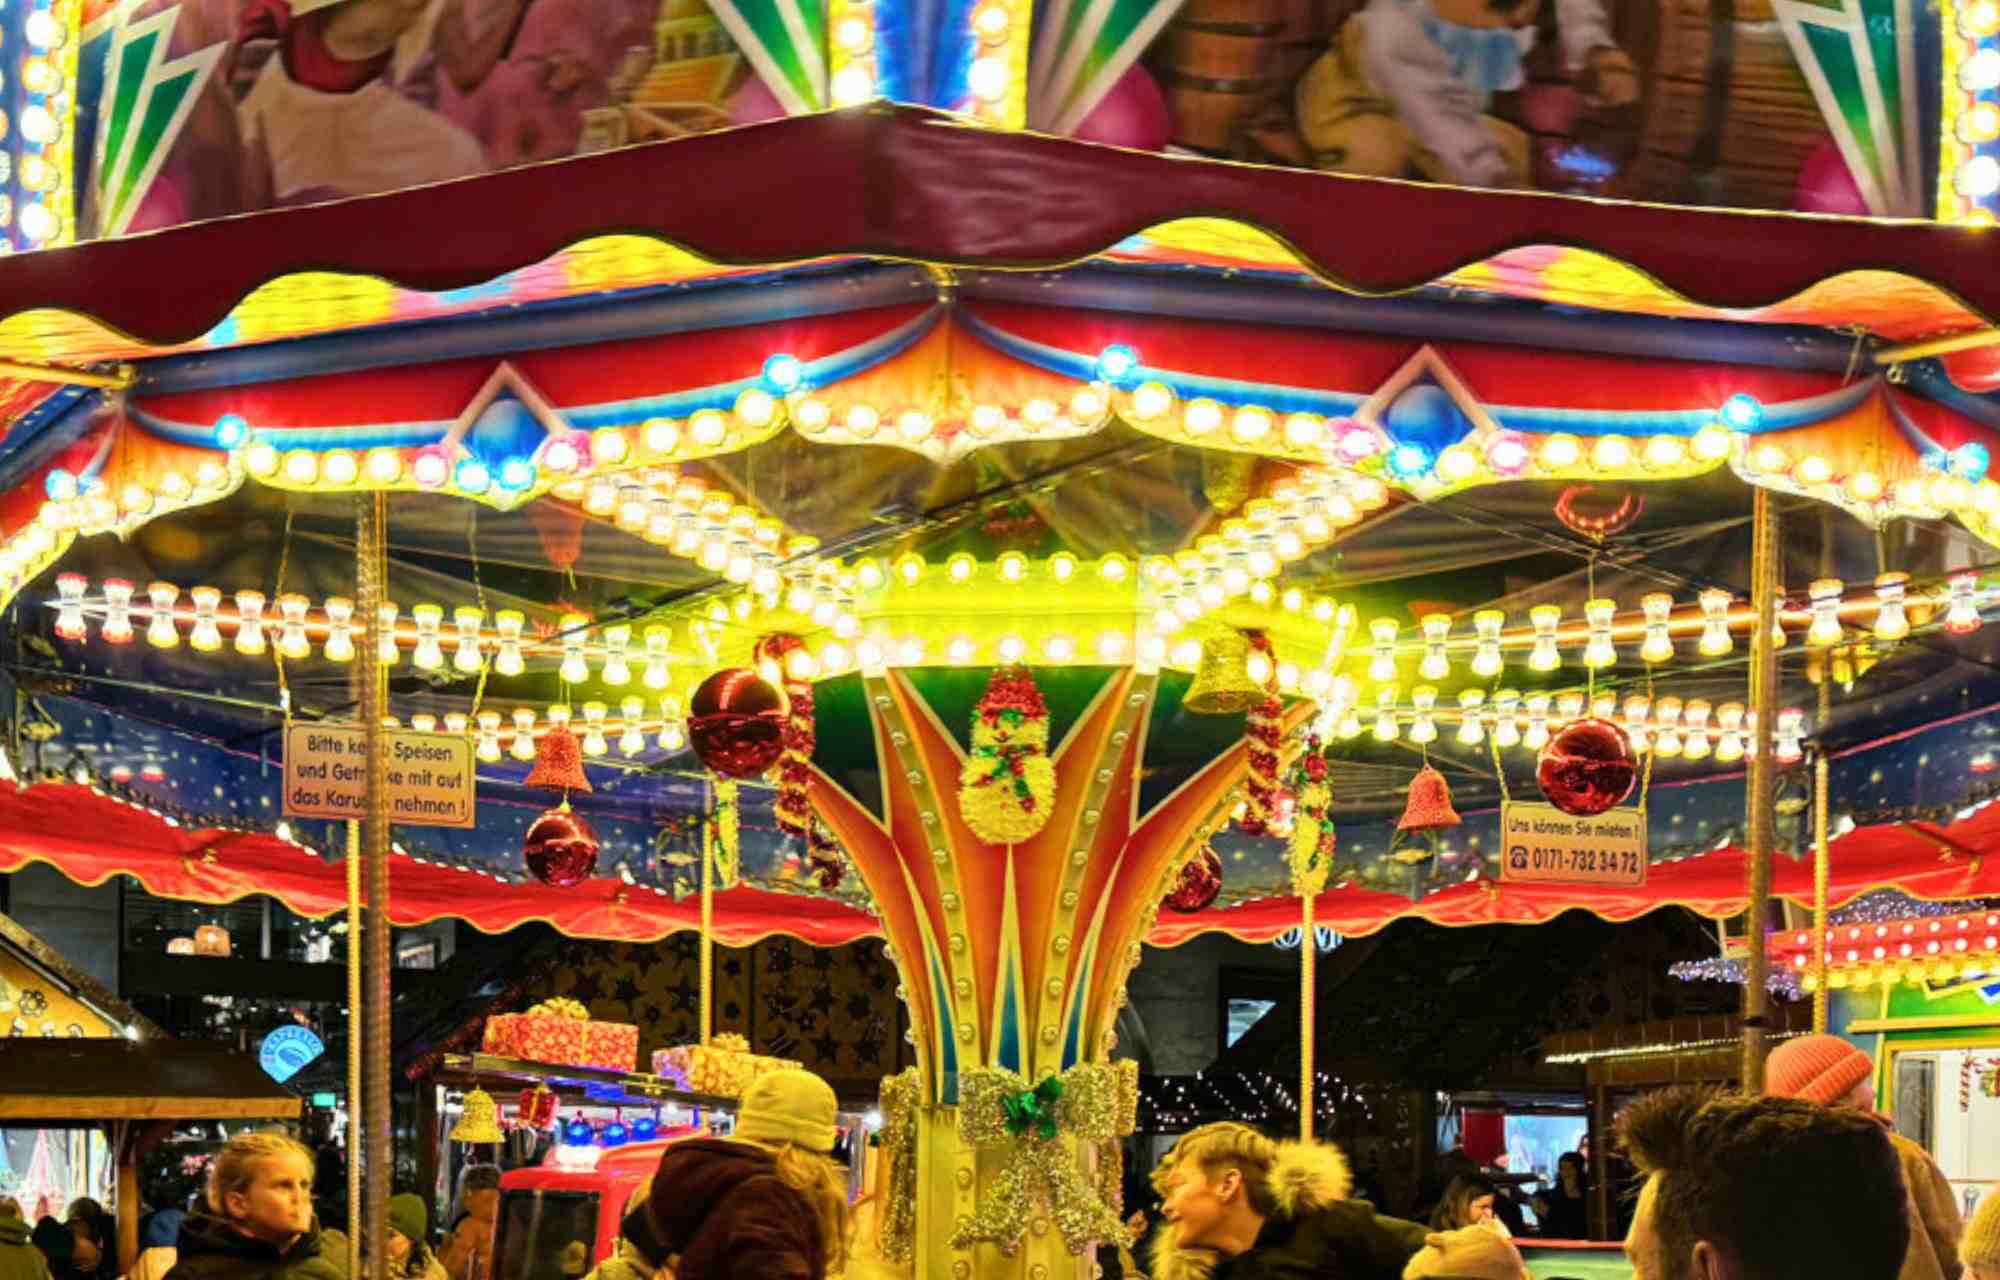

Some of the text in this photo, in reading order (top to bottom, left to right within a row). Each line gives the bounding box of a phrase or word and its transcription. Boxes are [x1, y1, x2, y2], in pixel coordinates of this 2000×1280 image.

[308, 735, 342, 753] Bitte
[394, 741, 452, 763] Speisen
[296, 762, 327, 779] und
[408, 769, 432, 786] mit
[436, 772, 463, 789] auf
[292, 787, 320, 806] das
[394, 796, 456, 815] nehmen
[1509, 817, 1529, 832] Uns
[1534, 818, 1572, 836] können
[1576, 820, 1592, 836] Sie
[1595, 822, 1632, 838] mieten
[1600, 850, 1618, 872] 34
[1620, 851, 1639, 874] 72
